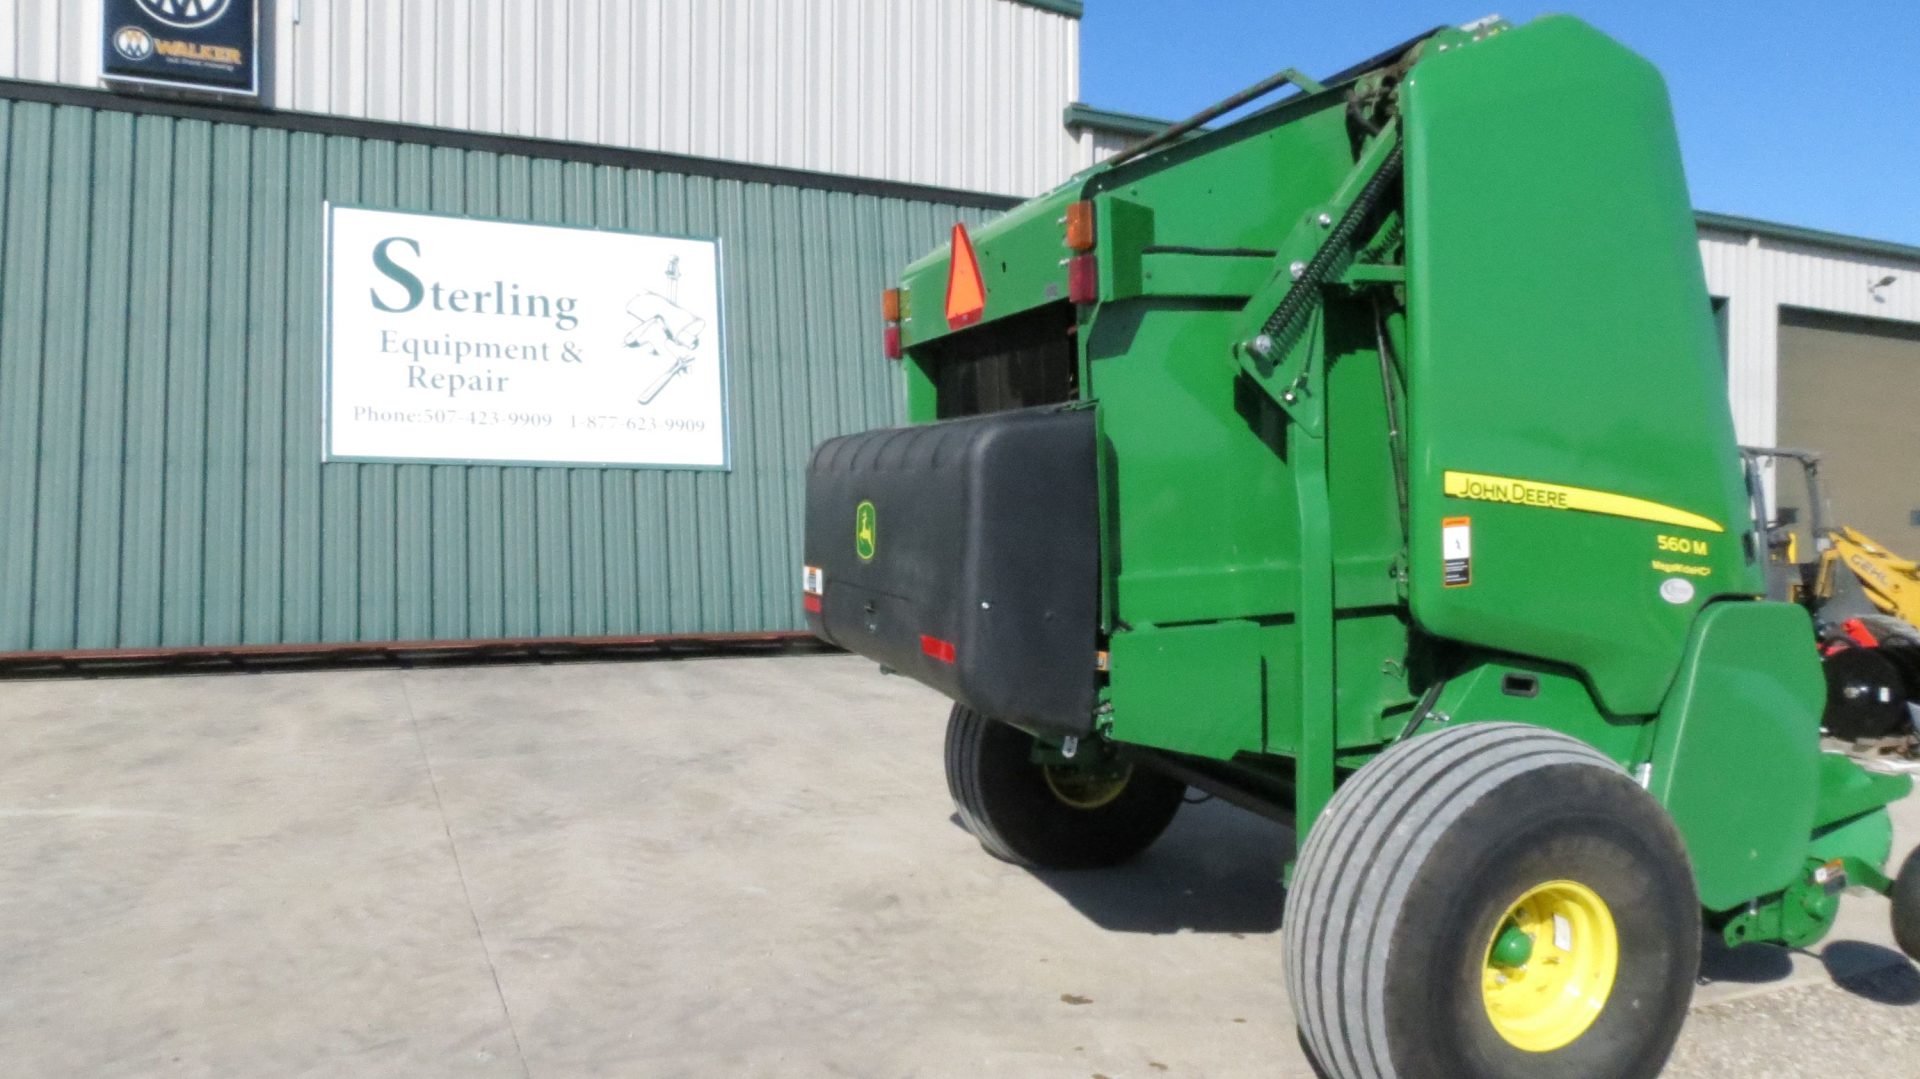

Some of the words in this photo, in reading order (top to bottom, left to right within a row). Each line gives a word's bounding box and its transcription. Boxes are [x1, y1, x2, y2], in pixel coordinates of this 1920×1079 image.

[154, 38, 242, 65] WALKER
[369, 236, 578, 331] Sterling
[380, 329, 549, 364] Equipment
[560, 340, 583, 363] &
[407, 364, 510, 398] Repair
[1459, 478, 1508, 500] JOHN
[1512, 483, 1568, 507] DEERE
[1656, 534, 1691, 554] 560
